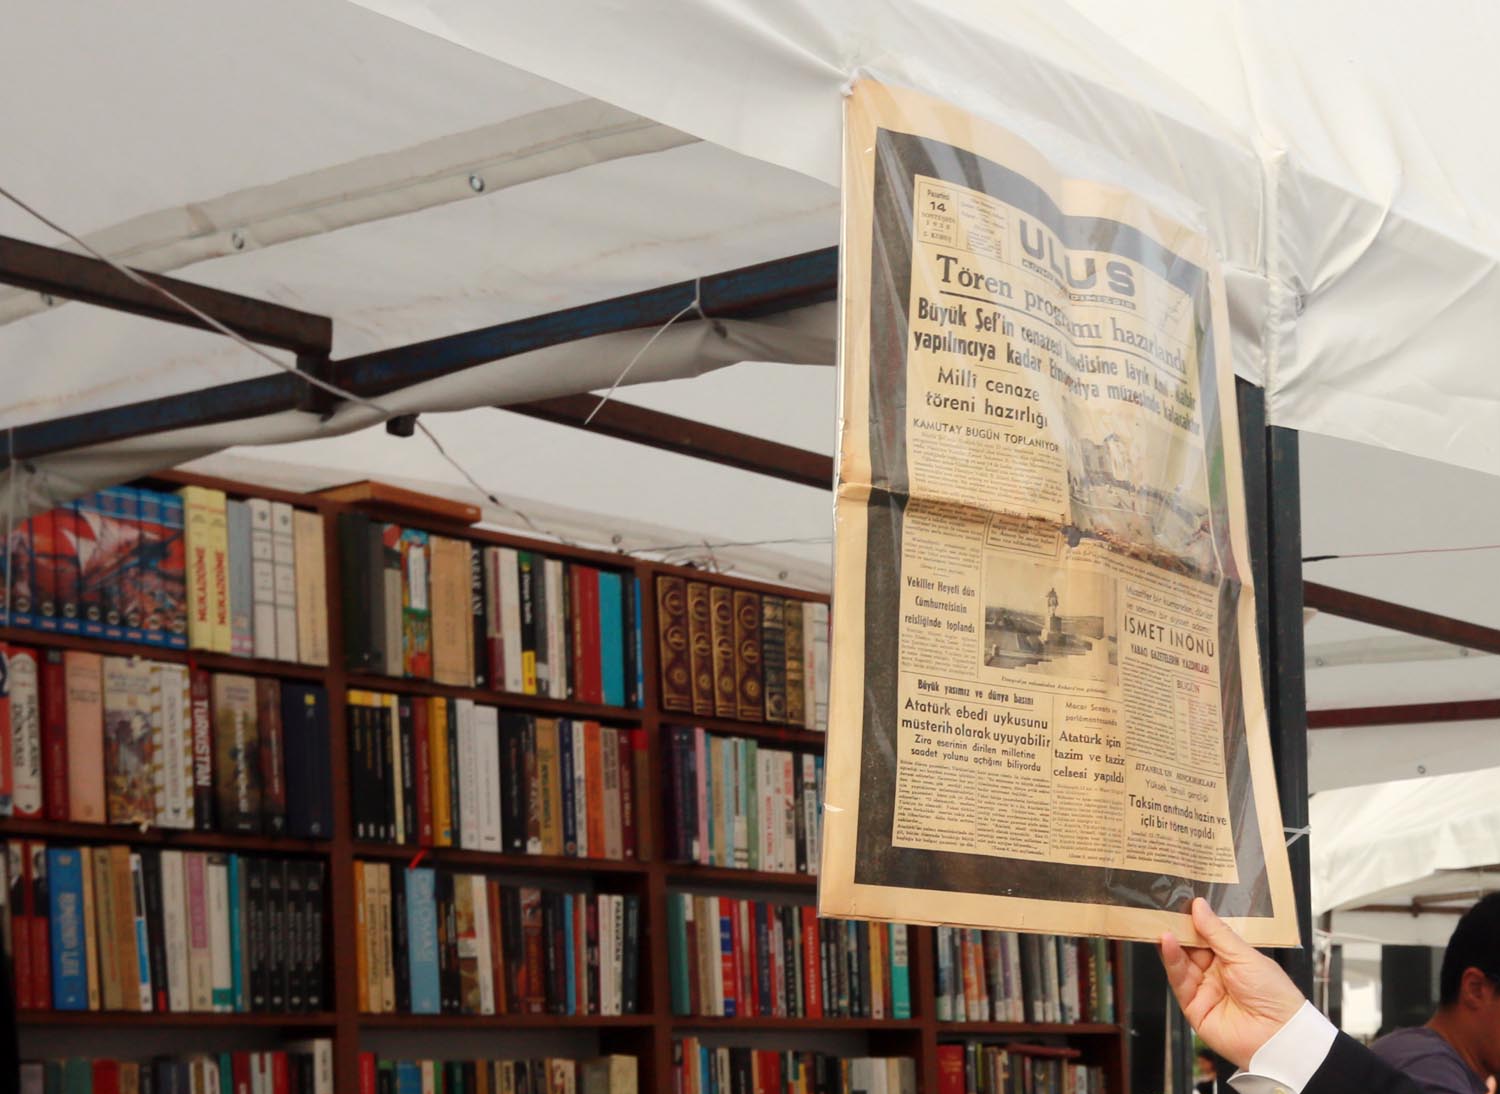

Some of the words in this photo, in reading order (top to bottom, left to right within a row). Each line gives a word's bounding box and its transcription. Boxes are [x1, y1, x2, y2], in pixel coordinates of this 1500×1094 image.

[929, 201, 947, 213] 14
[1019, 219, 1135, 297] ULUS
[936, 254, 1013, 299] Tören
[918, 297, 967, 327] Büyük
[974, 308, 1014, 338] Şef'in
[914, 331, 996, 362] yapılıncıya
[1006, 343, 1042, 372] kadar
[985, 380, 1040, 402] cenaze
[926, 391, 975, 413] töreni
[985, 399, 1048, 429] hazırlığı
[913, 418, 962, 435] KAMUTAY
[966, 426, 1000, 441] BUGÜN
[1004, 433, 1060, 452] TOPLANIYOR
[907, 576, 934, 591] Vekiller
[937, 582, 960, 596] Heyeti
[962, 585, 975, 597] dün
[904, 615, 942, 630] reisliğinde
[946, 620, 975, 634] toplandı
[918, 679, 939, 692] Büyük
[944, 684, 970, 698] yasımız
[975, 690, 983, 699] ve
[988, 690, 1009, 703] dünya
[905, 697, 951, 716] Atatürk
[993, 712, 1048, 730] uykusunu
[902, 718, 953, 735] müsterih
[955, 724, 991, 740] olarak
[993, 732, 1051, 748] uyuyabilir
[1059, 731, 1102, 746] Atatürk
[1106, 735, 1121, 749] için
[911, 747, 938, 758] saadet
[943, 751, 969, 763] yolunu
[973, 756, 1003, 767] açtığını
[1007, 760, 1041, 772] biliyordu
[914, 734, 932, 745] Zira
[937, 739, 968, 750] eserinin
[972, 743, 997, 755] dirilen
[1001, 747, 1036, 760] milletine
[1054, 749, 1083, 762] tazim
[1089, 753, 1102, 762] ve
[1105, 753, 1126, 767] taziz
[1053, 767, 1088, 780] celsesi
[1094, 769, 1124, 784] yapıldı
[1128, 793, 1162, 811] Taksim
[1163, 803, 1193, 819] anıtında
[1194, 808, 1215, 824] hazin
[1217, 816, 1227, 826] ve
[1140, 814, 1155, 828] içli
[1156, 815, 1168, 829] bir
[1190, 827, 1215, 840] yapıldı
